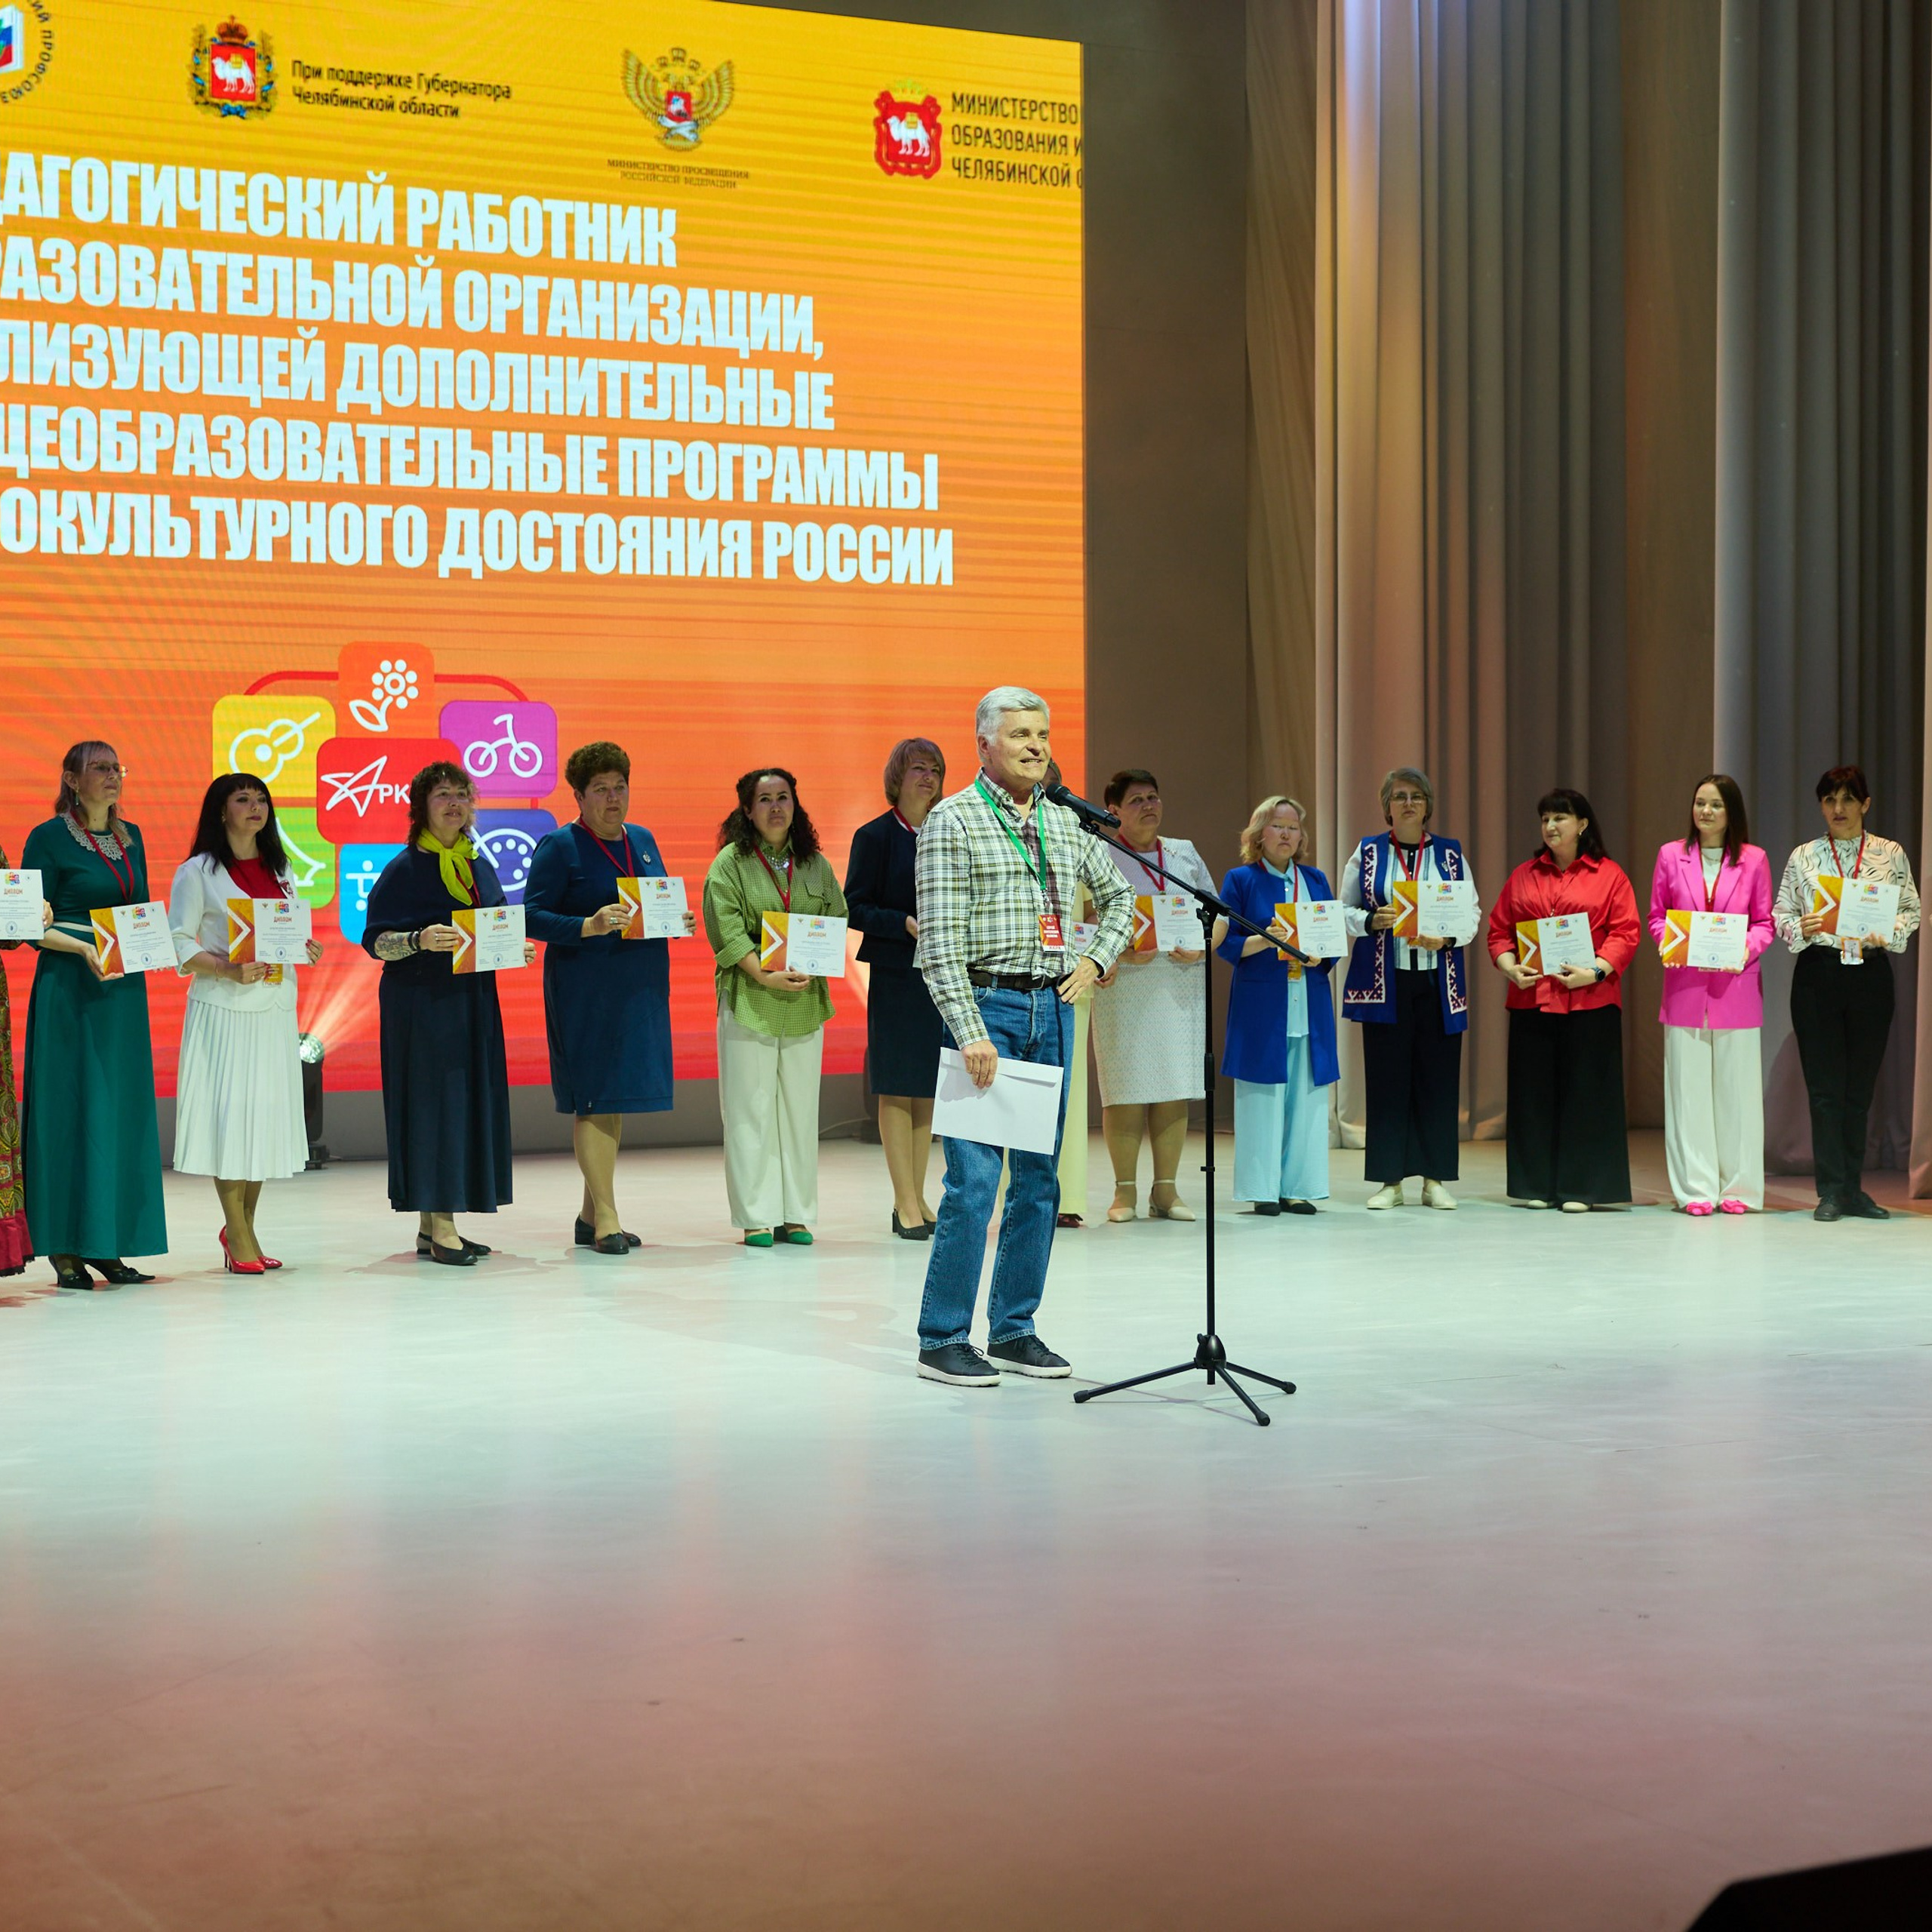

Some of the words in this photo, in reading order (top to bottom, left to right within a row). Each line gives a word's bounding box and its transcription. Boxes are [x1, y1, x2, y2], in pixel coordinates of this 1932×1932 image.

[292, 60, 321, 82] При
[327, 66, 412, 90] поддержке
[417, 72, 511, 102] Губернатора
[293, 85, 395, 112] Челябинской
[398, 97, 460, 118] области
[952, 92, 1078, 125] МИНИСТЕРСТВО
[952, 125, 1068, 155] ОБРАЗОВАНИЯ
[607, 159, 679, 173] МИНИСТЕРСТВО
[952, 156, 1070, 188] ЧЕЛЯБИНСКОЙ
[0, 152, 393, 245] АГОГИЧЕСКИЙ
[408, 187, 677, 267] РАБОТНИК
[0, 236, 441, 328] АЗОВАТЕЛЬНОЙ
[454, 270, 823, 361] ОРГАНИЗАЦИИ,
[0, 318, 325, 408] ЛИЗУЮЩЕЙ
[337, 342, 834, 429] ДОПОЛНИТЕЛЬНЫЕ
[618, 438, 938, 511] ПРОГРАММЫ
[0, 487, 427, 568] ОКУЛЬТУРНОГО
[438, 508, 752, 579] ДОСТОЯНИЯ
[763, 521, 952, 586] РОССИИ
